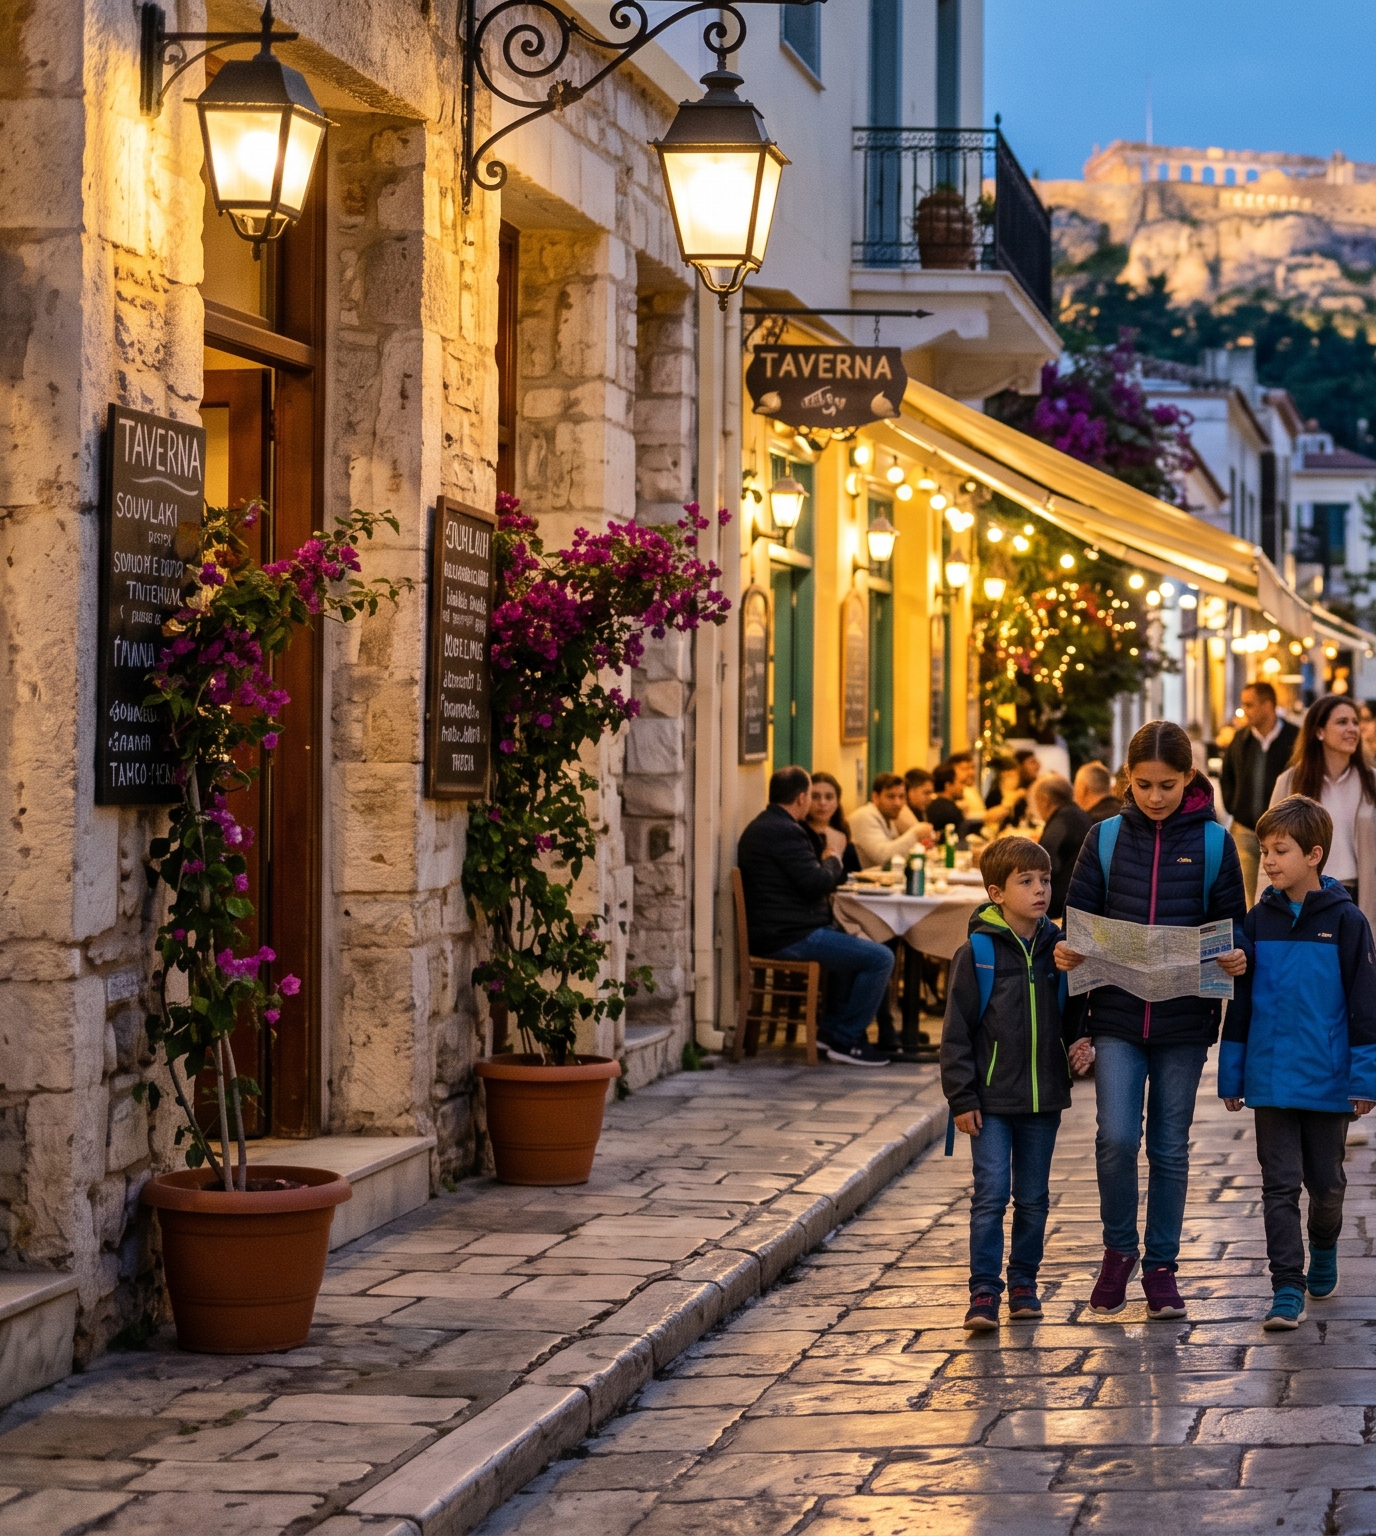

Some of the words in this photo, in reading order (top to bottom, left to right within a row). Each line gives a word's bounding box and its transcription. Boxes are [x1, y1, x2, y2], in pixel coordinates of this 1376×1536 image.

[760, 353, 892, 380] TAVERNA
[119, 418, 202, 482] TAVERNA
[116, 492, 178, 528] SOUVLAKI
